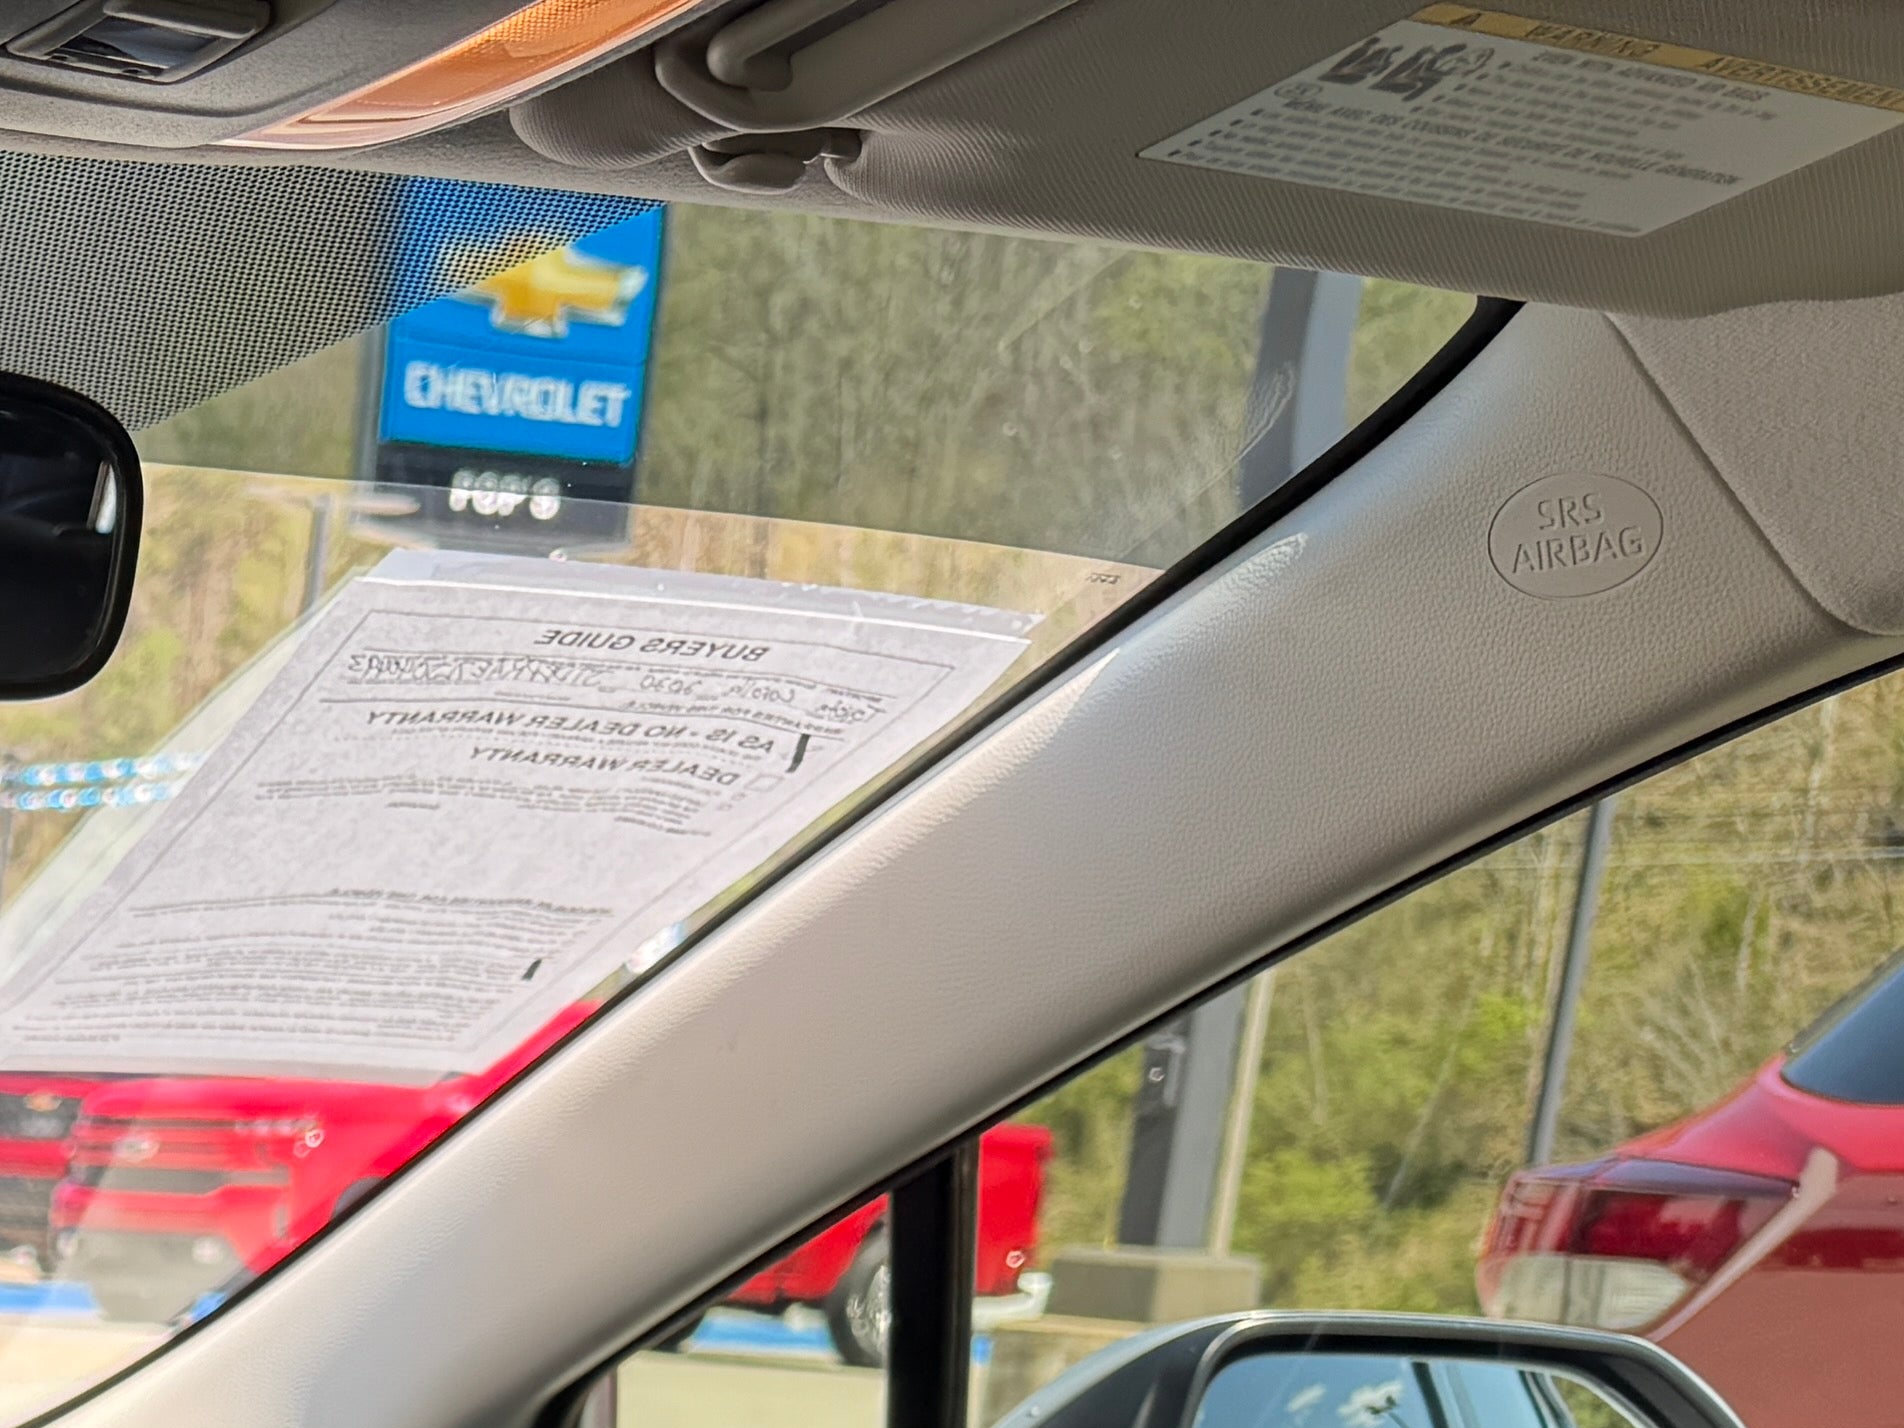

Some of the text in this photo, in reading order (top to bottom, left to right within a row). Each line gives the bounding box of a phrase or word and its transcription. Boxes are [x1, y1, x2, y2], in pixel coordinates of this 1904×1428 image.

[404, 360, 632, 427] CHEVROLET
[1537, 493, 1602, 532] SRS
[1511, 525, 1643, 576] AIRBAG
